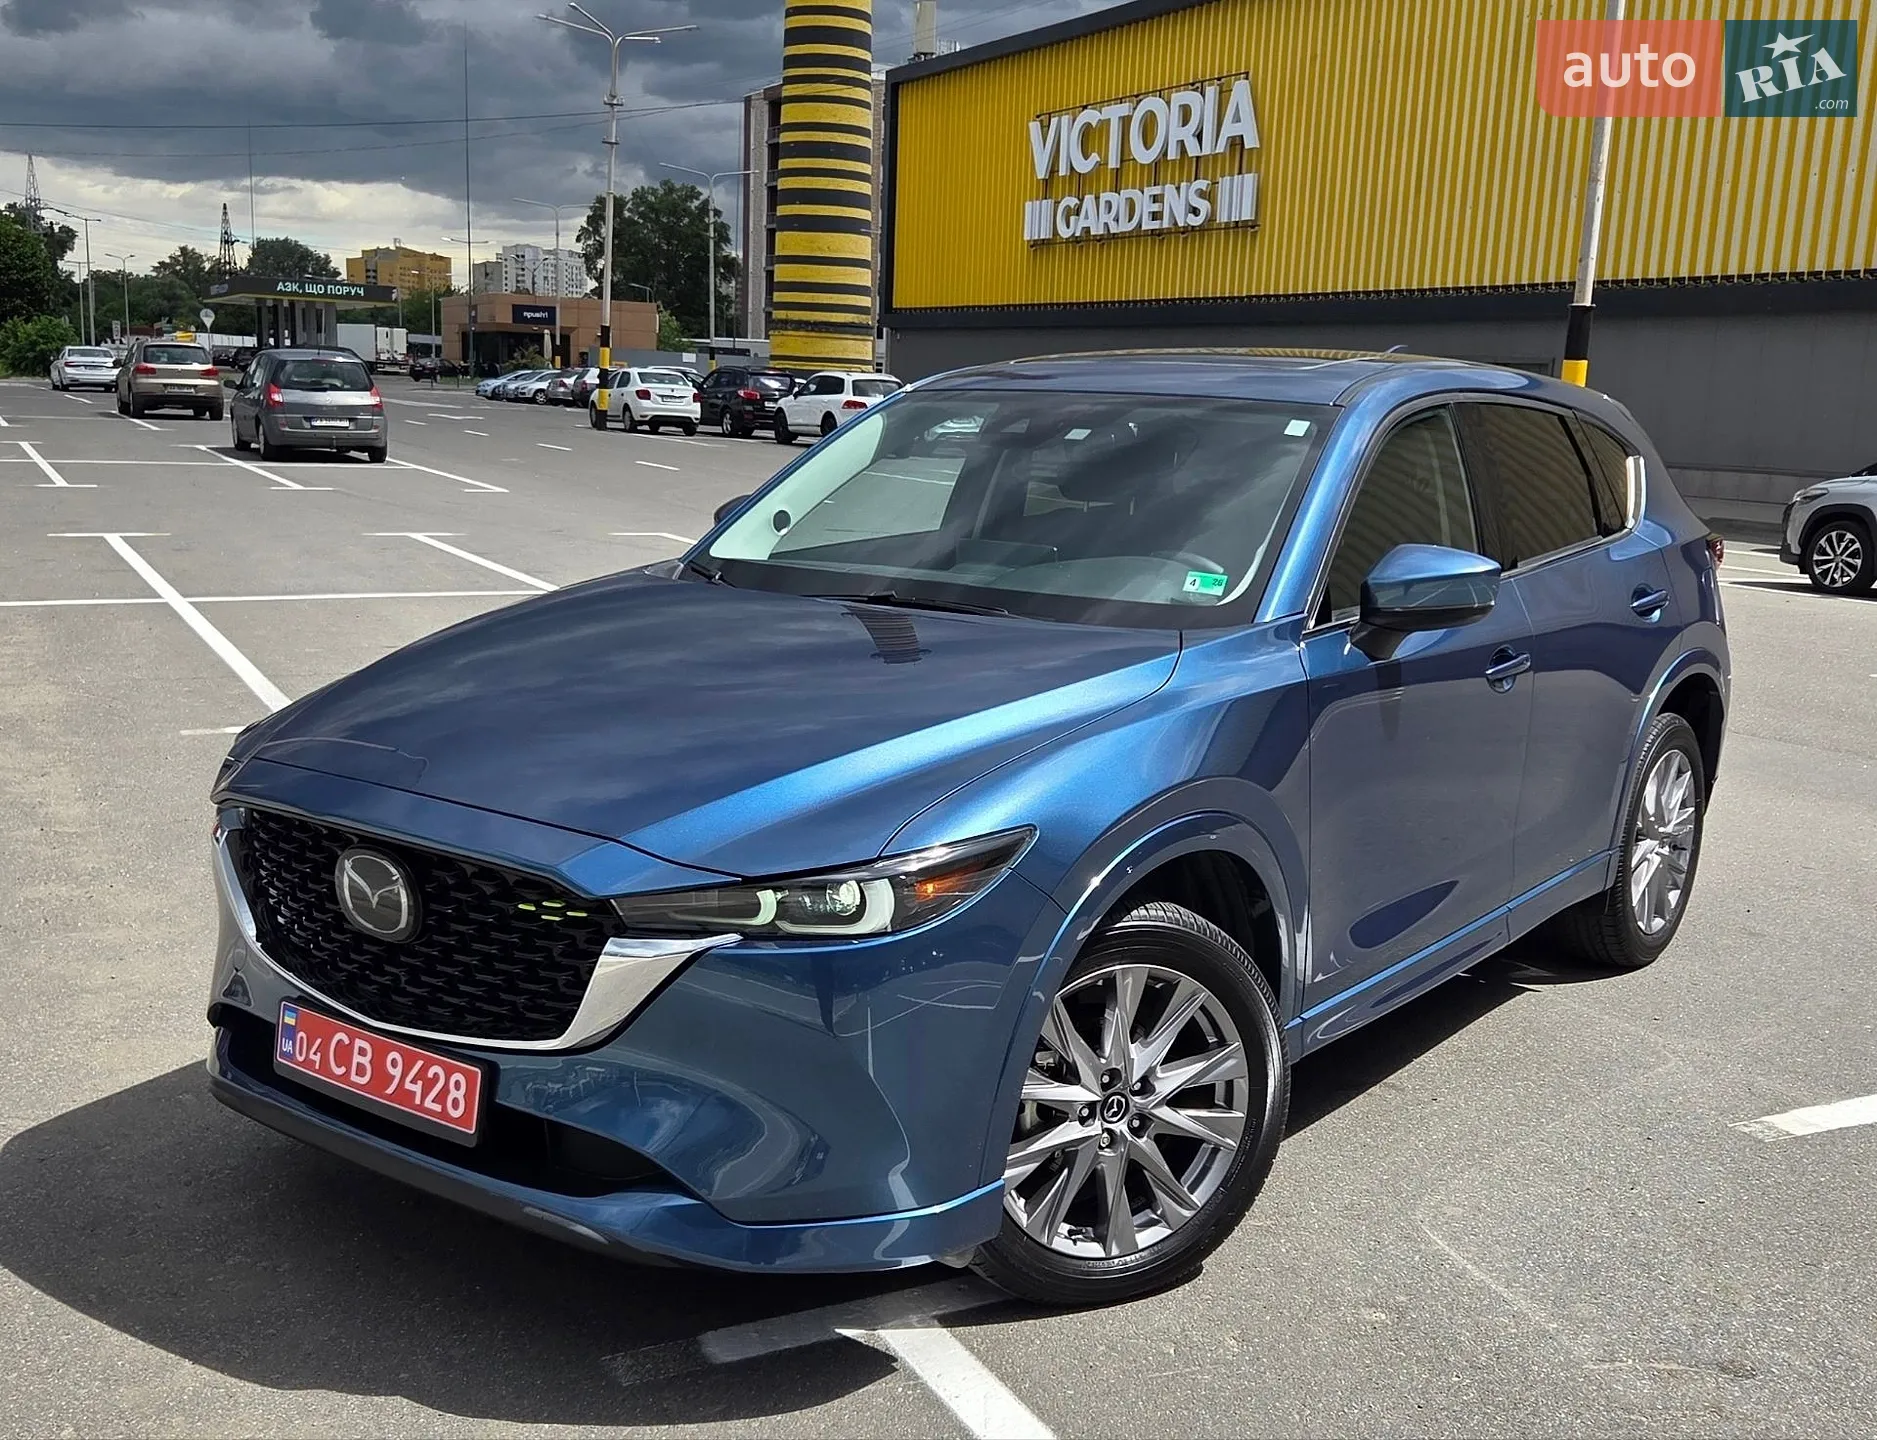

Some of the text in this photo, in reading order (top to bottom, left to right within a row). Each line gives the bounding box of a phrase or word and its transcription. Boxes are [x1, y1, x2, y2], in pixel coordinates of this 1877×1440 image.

[1028, 79, 1260, 180] VICTORIA
[1056, 179, 1211, 239] GARDENS
[276, 281, 364, 297] АЗК, ЩО ПОРУЧ
[282, 1037, 293, 1054] UA
[295, 1031, 322, 1070] 04
[384, 1051, 467, 1118] 9428
